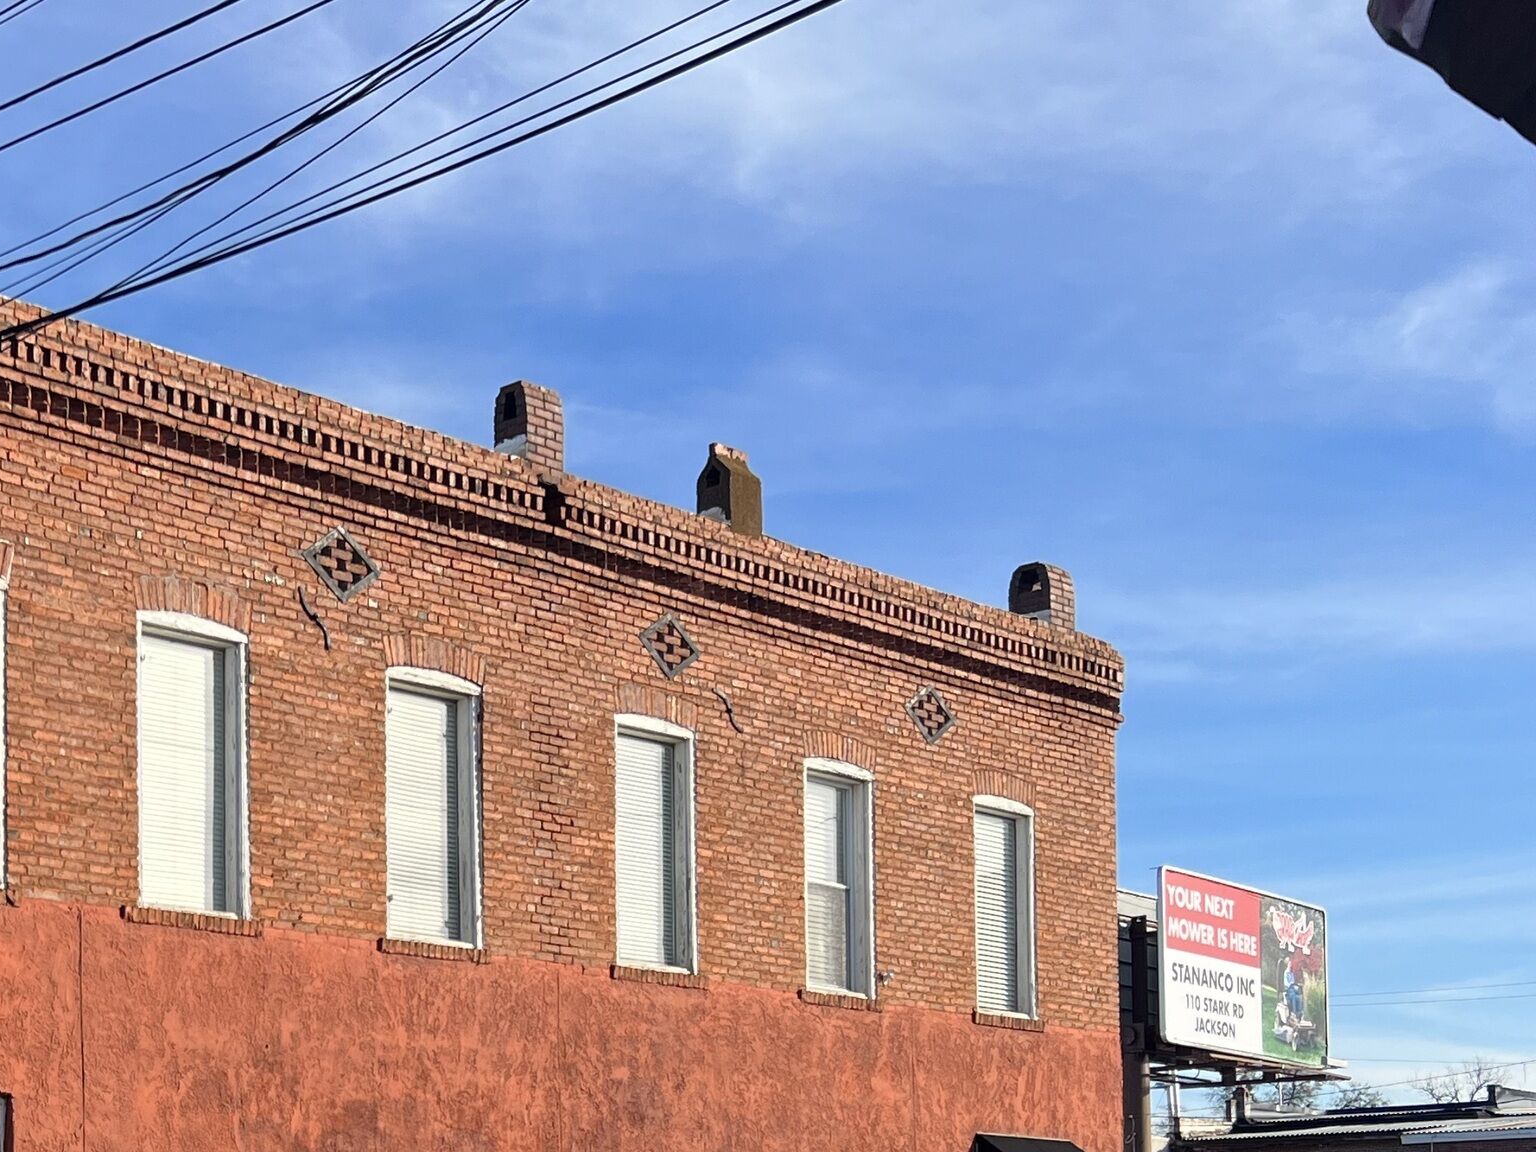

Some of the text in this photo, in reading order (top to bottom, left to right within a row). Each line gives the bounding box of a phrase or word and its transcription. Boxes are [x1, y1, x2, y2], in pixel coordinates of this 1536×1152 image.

[1167, 884, 1235, 920] YOUR NEXT
[1168, 916, 1257, 956] MOWER IS HERE
[1172, 962, 1255, 998] STANANCO INC
[1185, 994, 1244, 1019] 110 STARK RD
[1194, 1017, 1236, 1039] JACKSON
